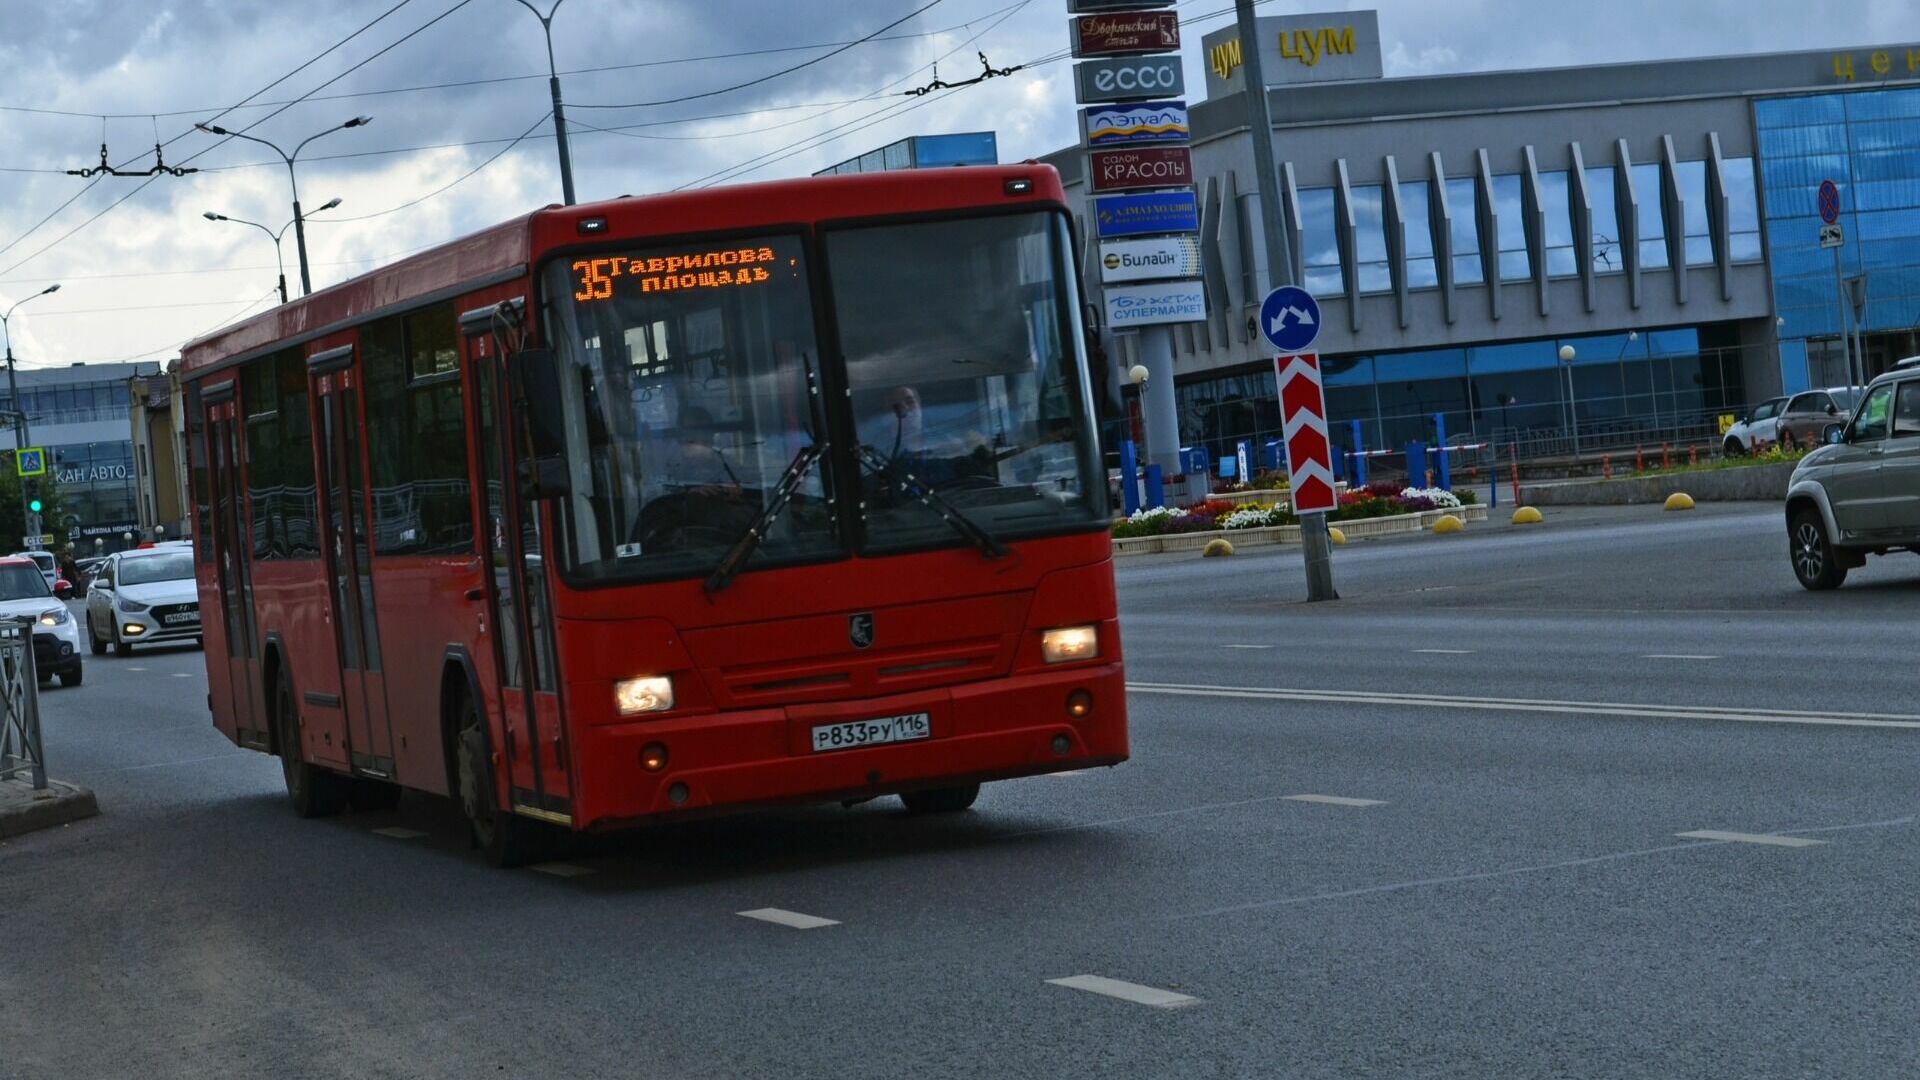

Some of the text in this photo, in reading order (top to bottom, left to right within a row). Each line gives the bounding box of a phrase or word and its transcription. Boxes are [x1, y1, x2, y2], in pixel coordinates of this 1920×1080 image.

[1081, 17, 1157, 37] Дворянский
[1279, 26, 1355, 66] ЦУМ
[1210, 38, 1242, 80] ЦУМ
[1095, 66, 1174, 91] ecco
[1104, 161, 1185, 180] КРАСОТЫ
[610, 247, 775, 276] Гаврилова
[1122, 251, 1175, 267] Билайн
[572, 258, 612, 301] 35
[641, 267, 770, 292] площадь
[1113, 304, 1203, 320] СУПЕРМАРКЕТ
[56, 464, 126, 483] КАН АВТО
[895, 715, 922, 732] 116
